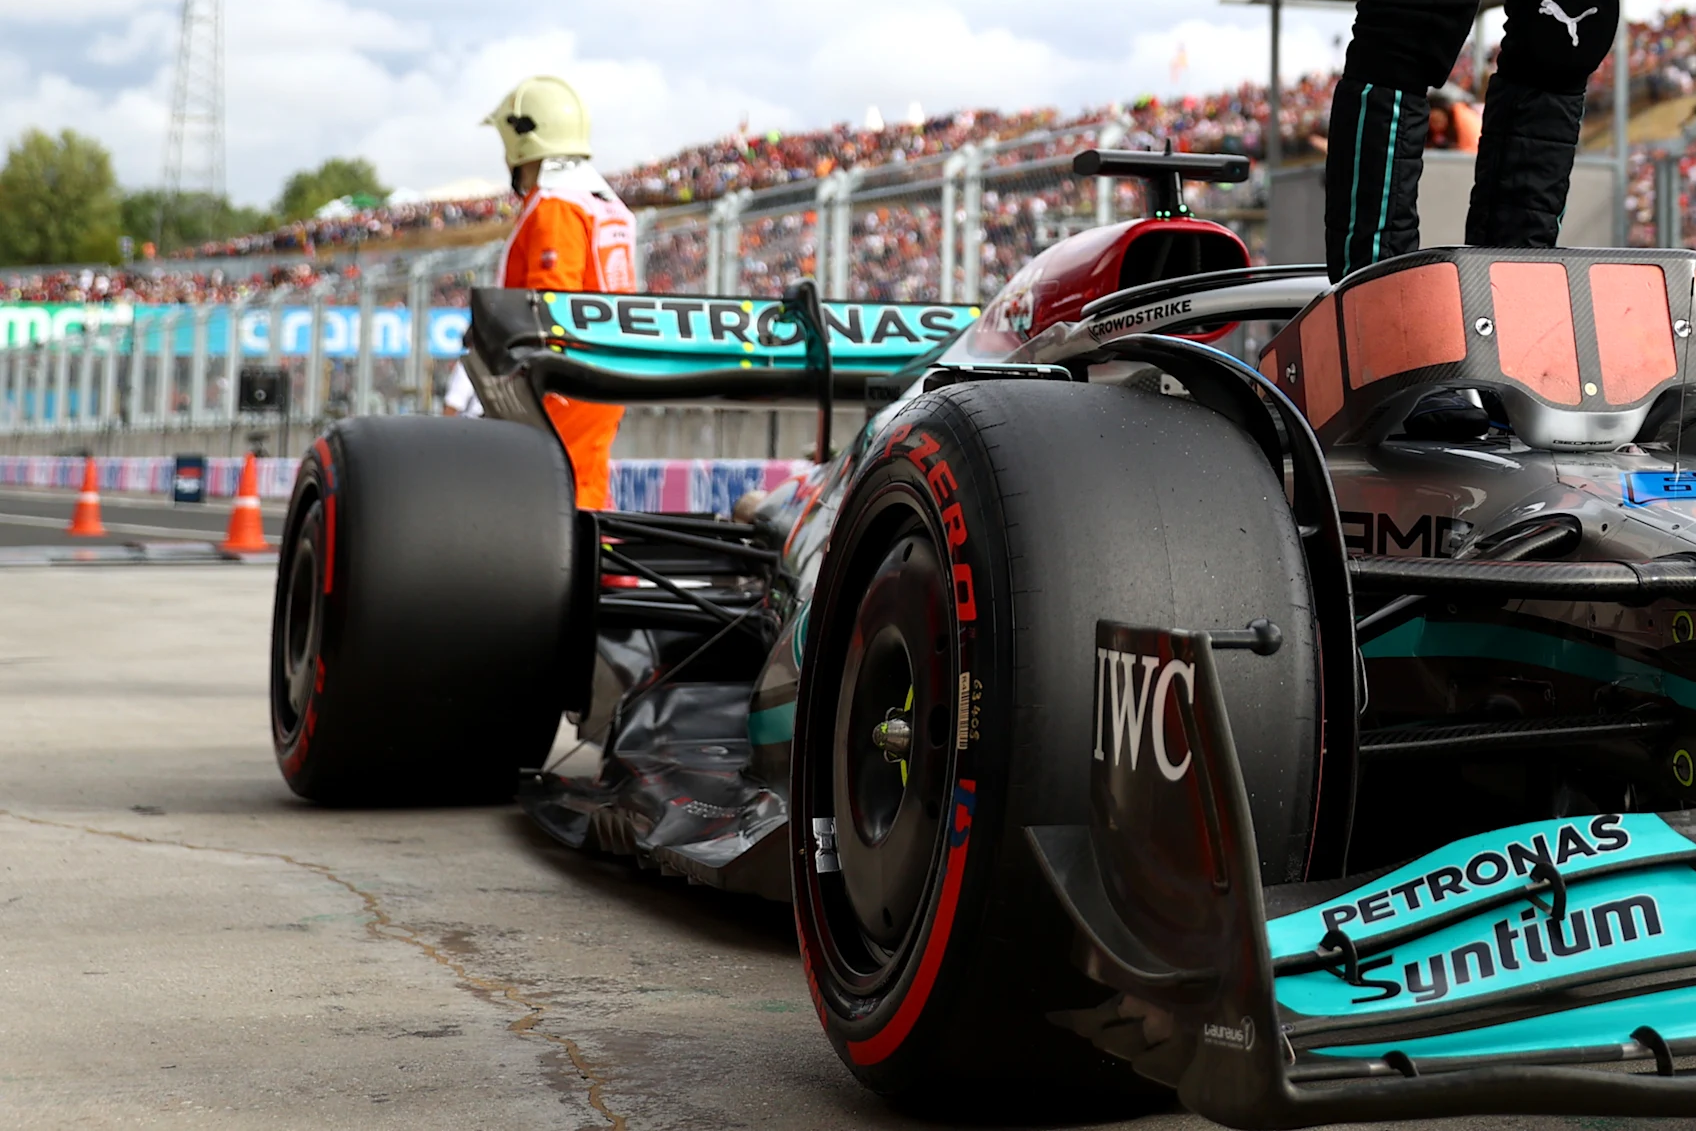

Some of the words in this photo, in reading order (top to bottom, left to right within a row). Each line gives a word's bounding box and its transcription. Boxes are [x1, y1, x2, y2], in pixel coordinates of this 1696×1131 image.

[568, 295, 960, 349] PETRONAS
[1092, 299, 1192, 337] CROWDSTRIKE
[909, 432, 977, 621] ZERO
[1094, 647, 1195, 782] IWC
[1320, 813, 1631, 933] PETRONAS
[1350, 893, 1664, 1005] Syntium
